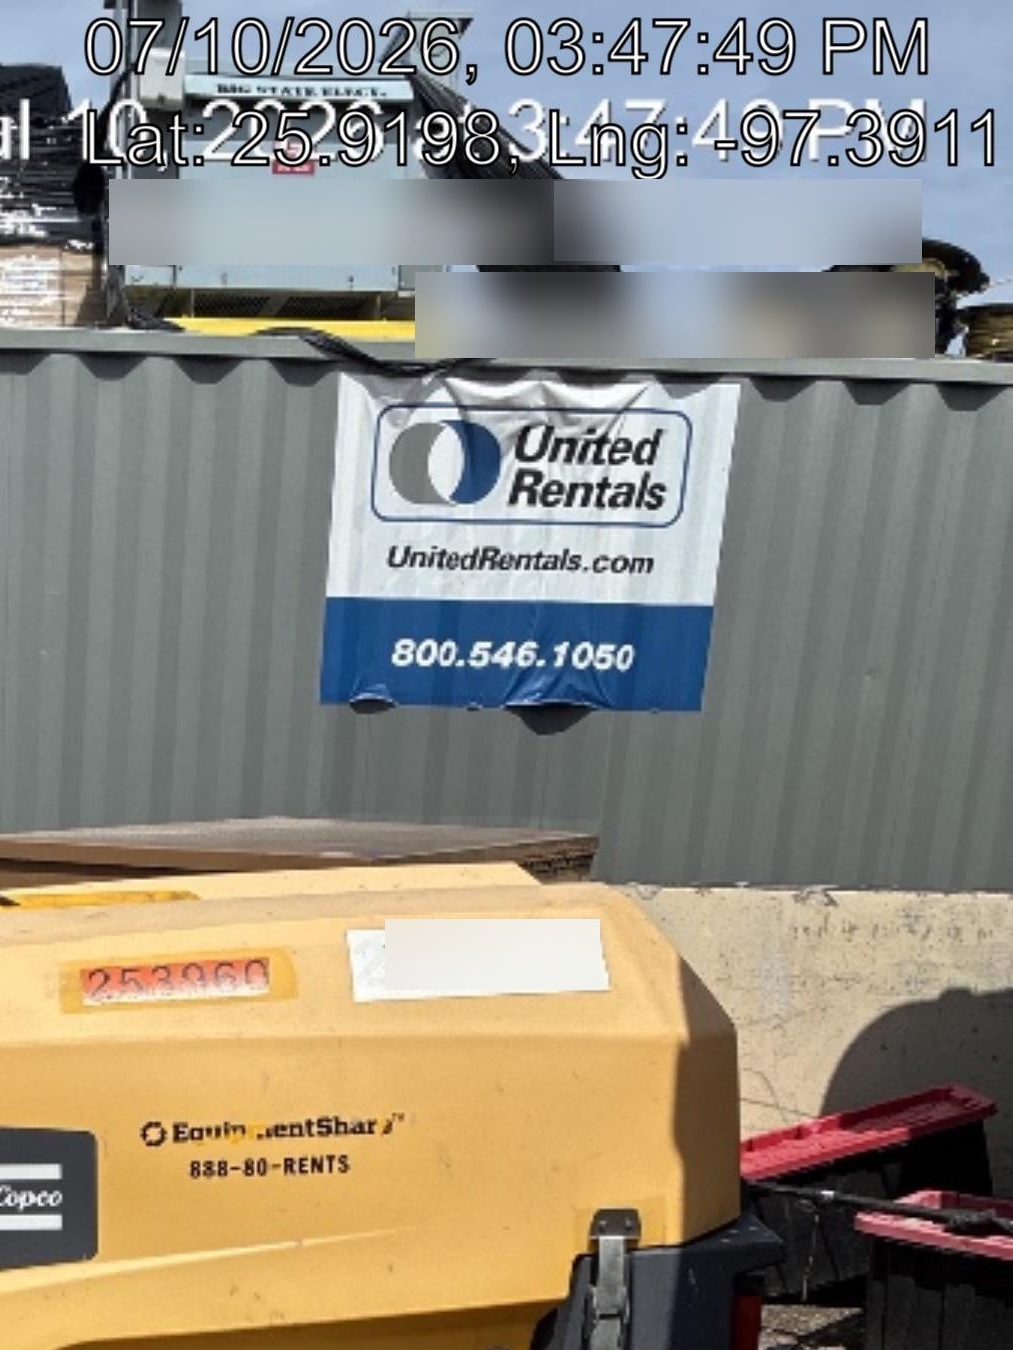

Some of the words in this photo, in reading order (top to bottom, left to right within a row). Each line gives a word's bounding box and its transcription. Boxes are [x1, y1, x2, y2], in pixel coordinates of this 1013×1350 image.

[513, 424, 664, 467] United
[508, 469, 667, 511] Rentals
[386, 545, 654, 575] UnitedRentals.com
[391, 639, 636, 672] 800.546.1050
[190, 1154, 350, 1179] 888-80-RENTS
